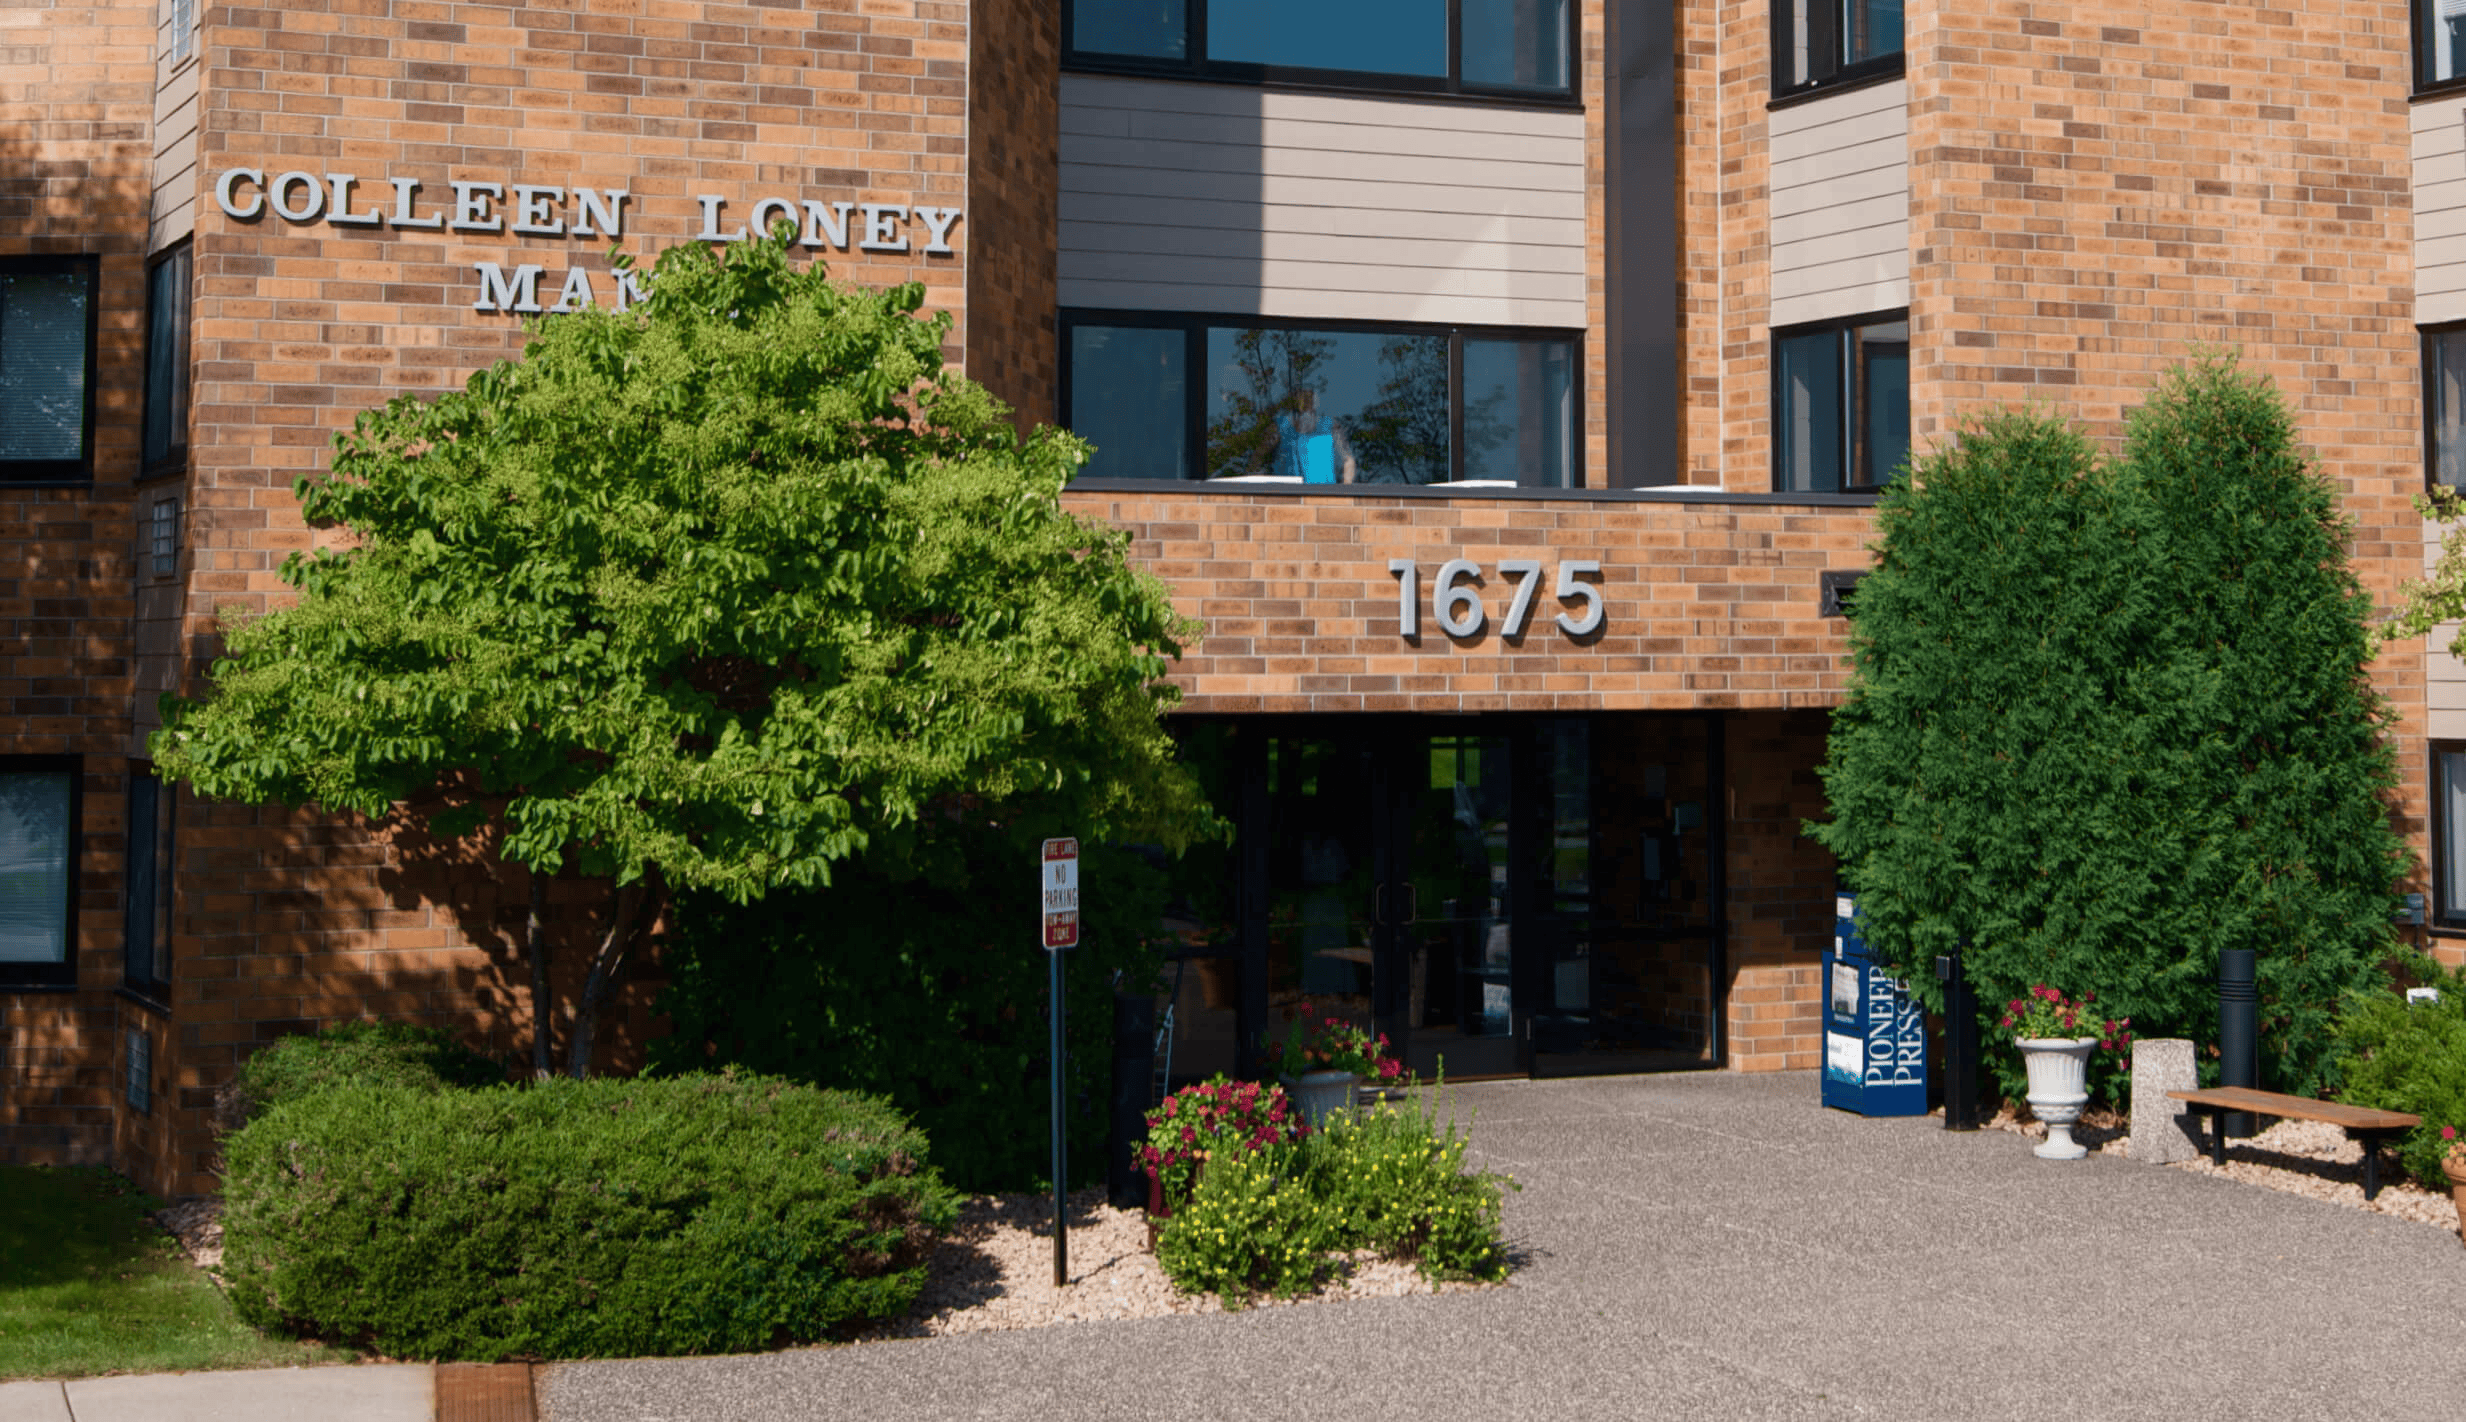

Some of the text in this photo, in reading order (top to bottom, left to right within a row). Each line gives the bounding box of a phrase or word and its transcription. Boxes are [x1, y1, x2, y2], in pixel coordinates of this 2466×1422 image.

[214, 166, 962, 255] COLLEEN LONEY
[1387, 557, 1605, 638] 1675
[1045, 887, 1078, 908] PARKING
[1055, 863, 1067, 885] NO
